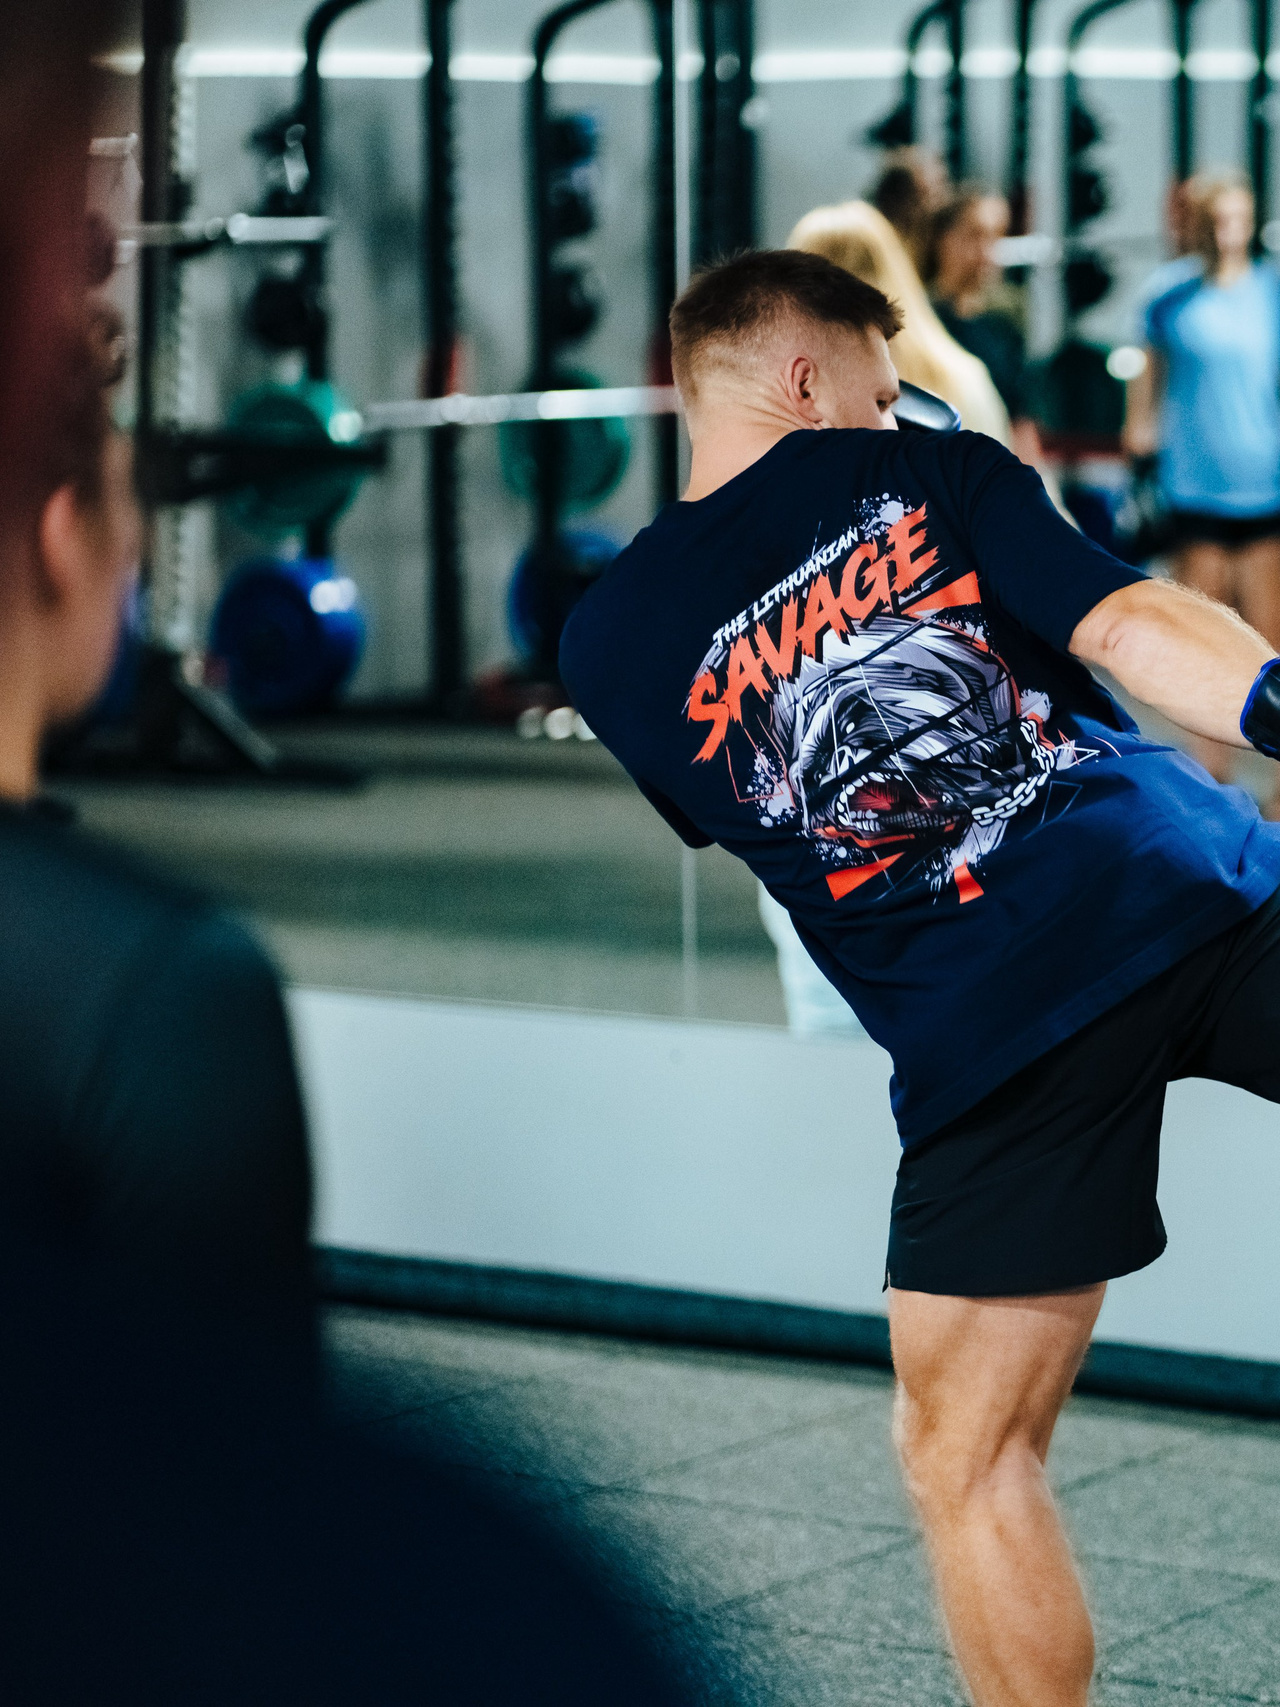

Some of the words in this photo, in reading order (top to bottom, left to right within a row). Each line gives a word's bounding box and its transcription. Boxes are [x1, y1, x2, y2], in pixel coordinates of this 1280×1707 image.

[687, 502, 940, 763] SAVAGE
[712, 609, 750, 649] THE
[753, 526, 860, 622] LITHUANIAN
